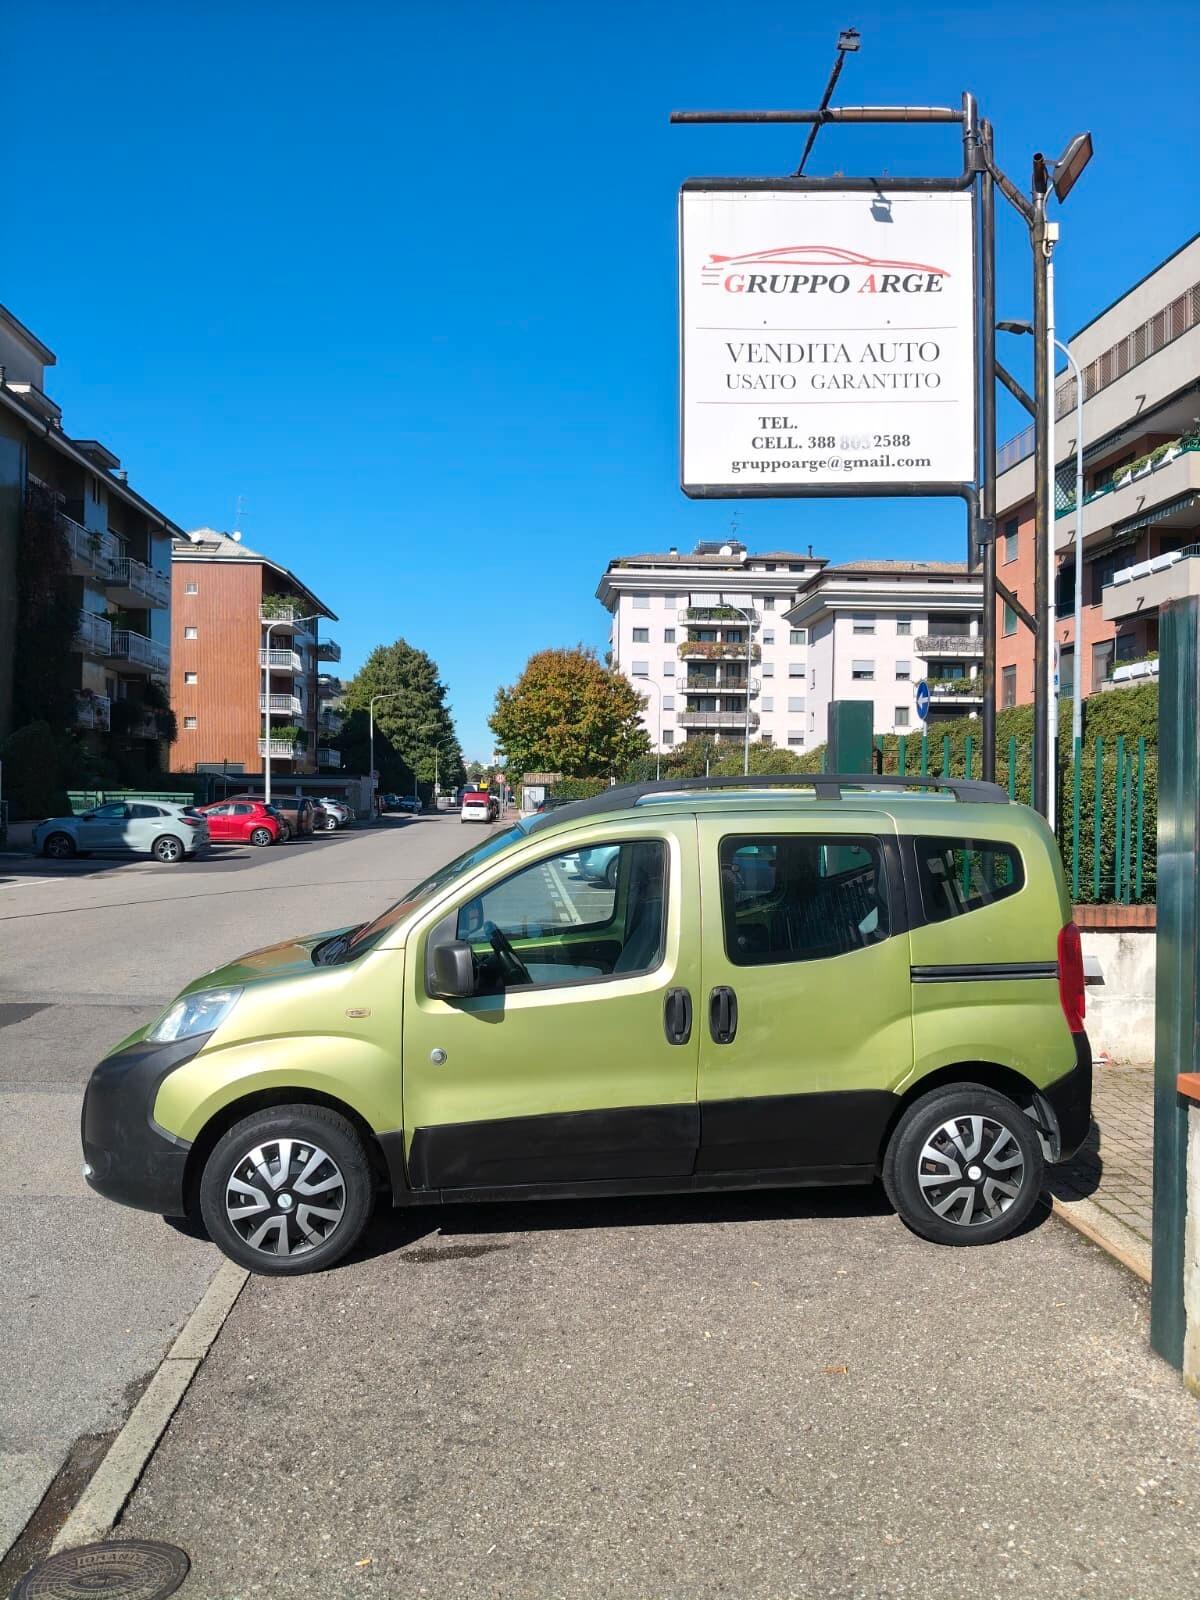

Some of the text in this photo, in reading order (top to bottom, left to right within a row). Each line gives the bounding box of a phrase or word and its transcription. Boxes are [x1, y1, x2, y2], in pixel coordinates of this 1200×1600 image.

[724, 274, 944, 294] GRUPPO ARGE
[725, 341, 941, 364] VENDITA AUTO
[725, 373, 941, 390] USATO GARANTITO
[758, 416, 798, 430] TEL.
[751, 436, 803, 450] CELL.
[807, 436, 836, 449] 388
[873, 434, 911, 448] 2588
[731, 454, 932, 473] gruppoarge@gmail.com
